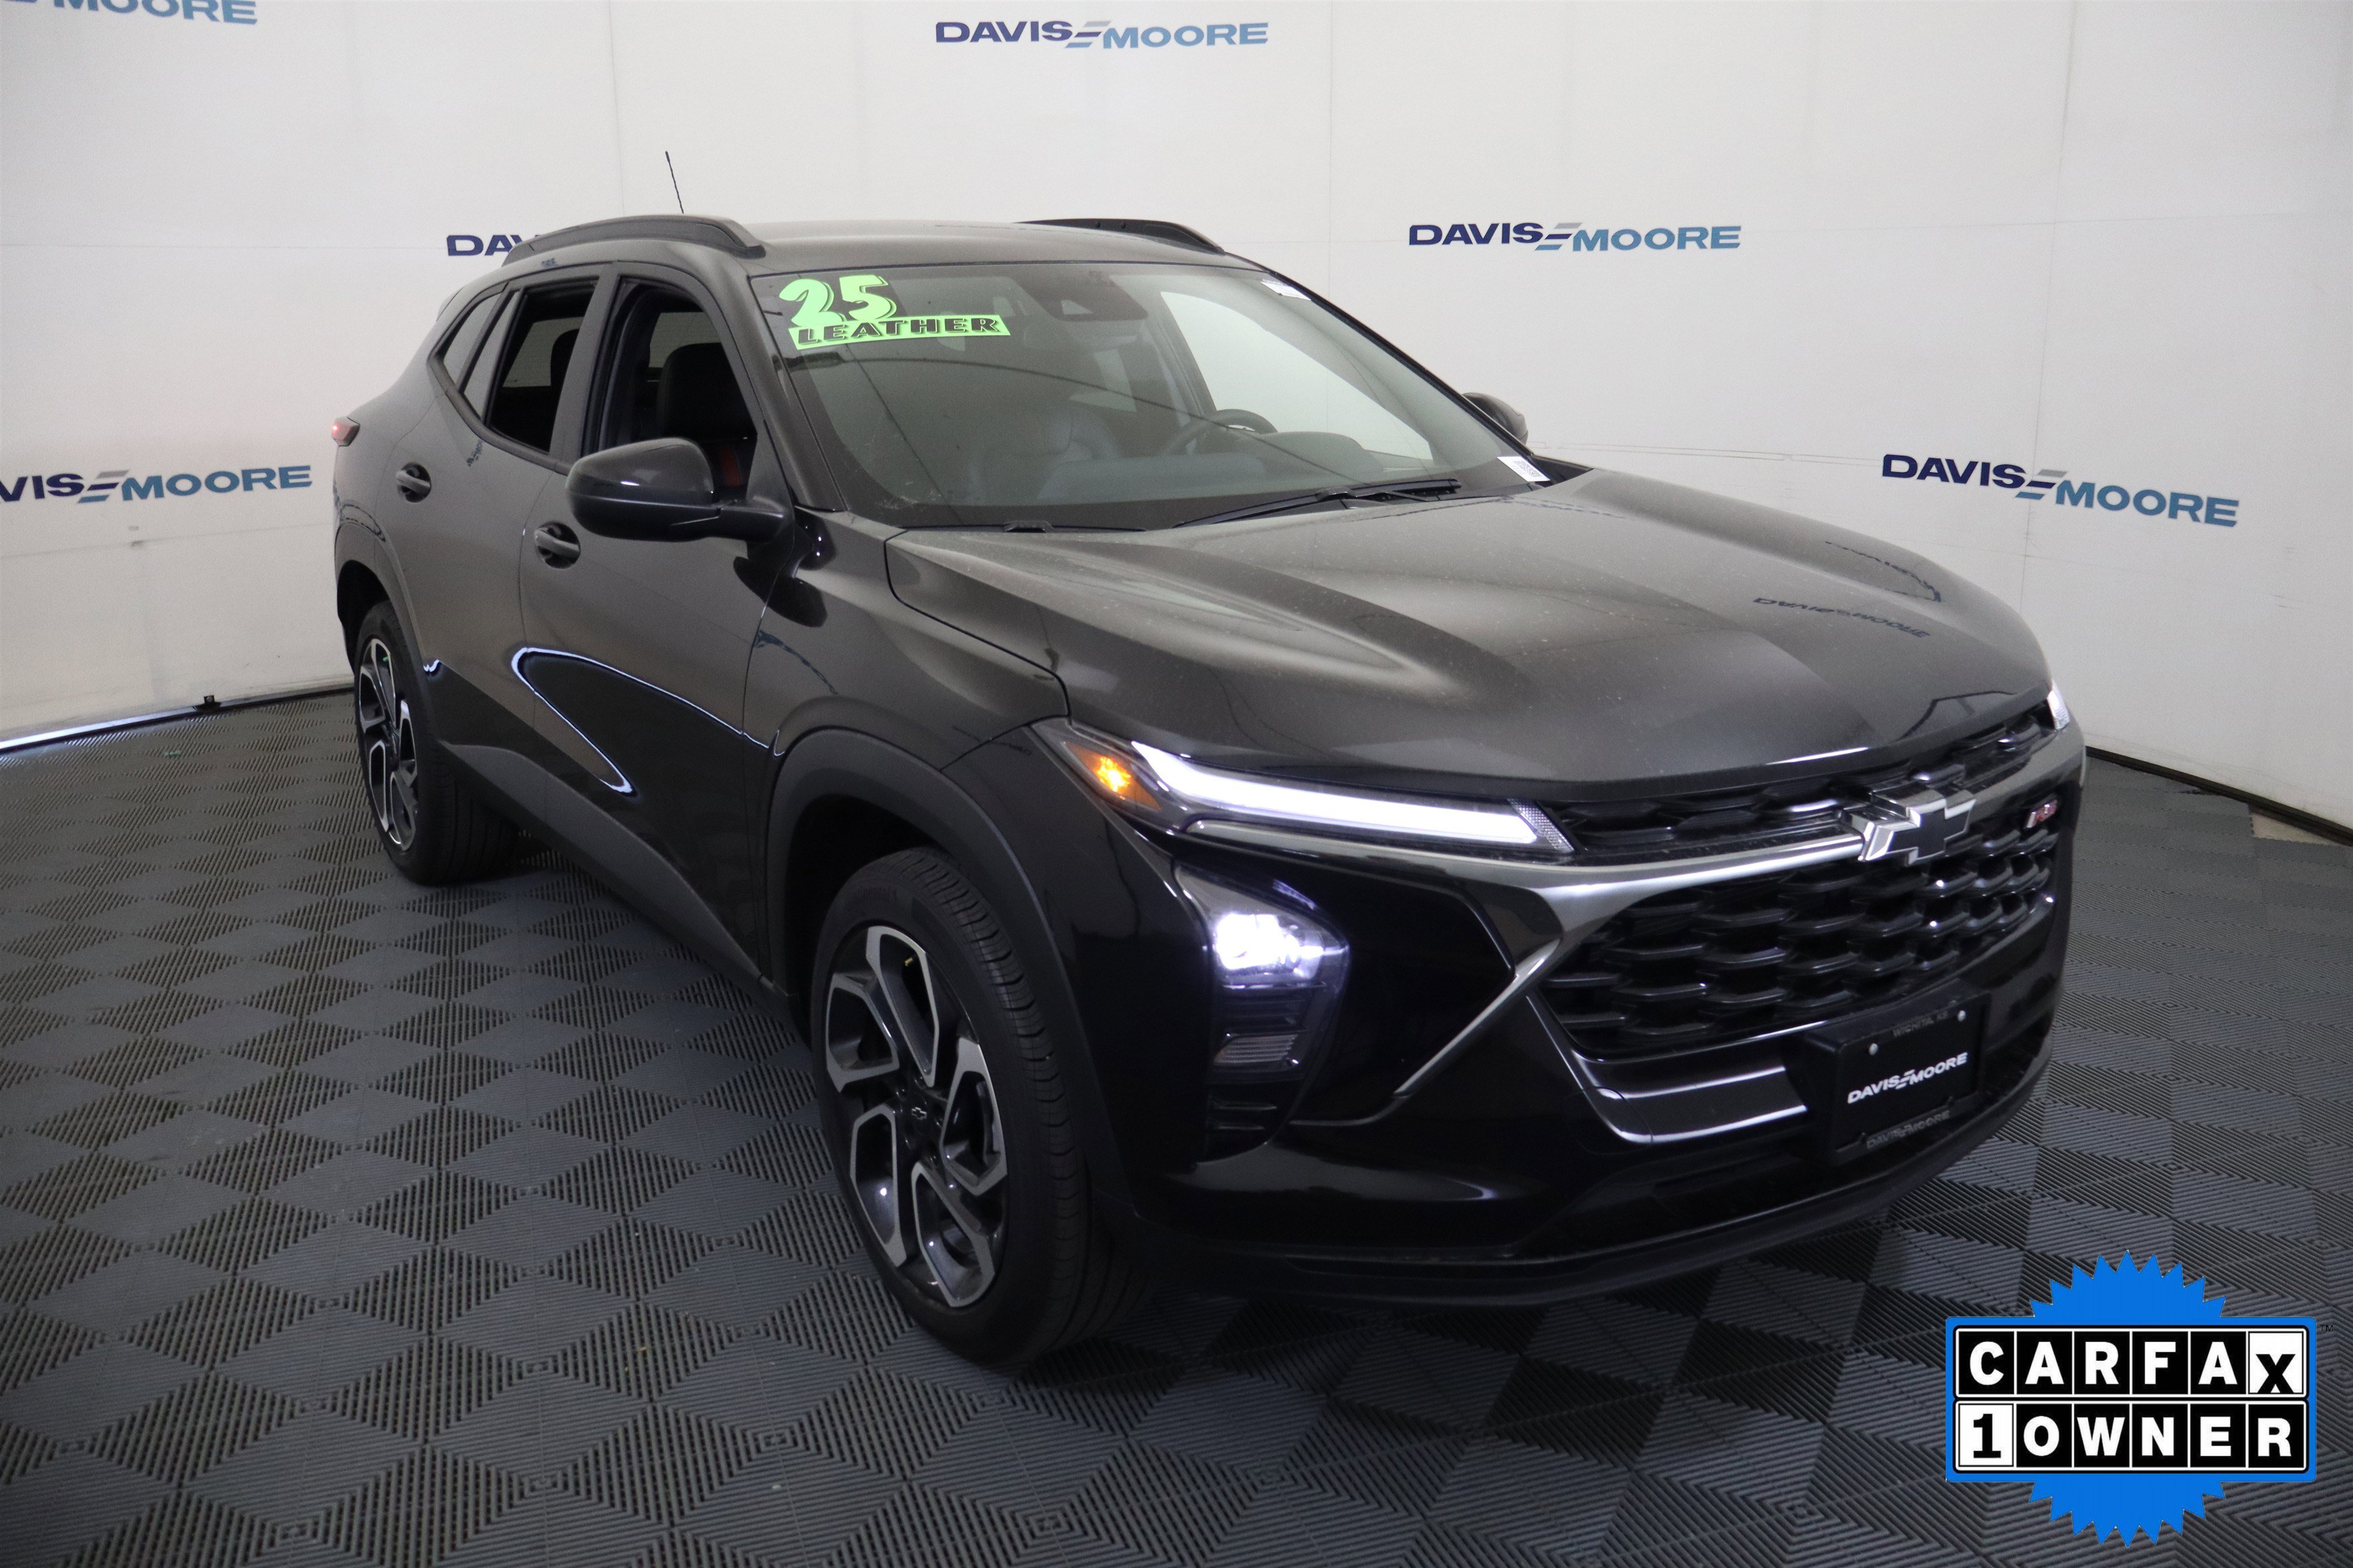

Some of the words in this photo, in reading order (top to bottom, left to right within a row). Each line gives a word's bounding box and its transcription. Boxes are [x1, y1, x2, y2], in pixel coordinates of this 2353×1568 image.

[935, 20, 1073, 43] DAVIS
[1102, 22, 1268, 49] MOORE
[1409, 222, 1544, 245] DAVIS
[1572, 225, 1742, 252] MOORE
[778, 274, 897, 328] 25
[797, 317, 1001, 346] LEATHER
[121, 465, 313, 501] MOORE
[1882, 454, 2027, 489] DAVIS
[2055, 480, 2239, 527] MOORE
[1847, 1075, 1901, 1104] DAVIS
[1909, 1052, 1968, 1085] MOORE
